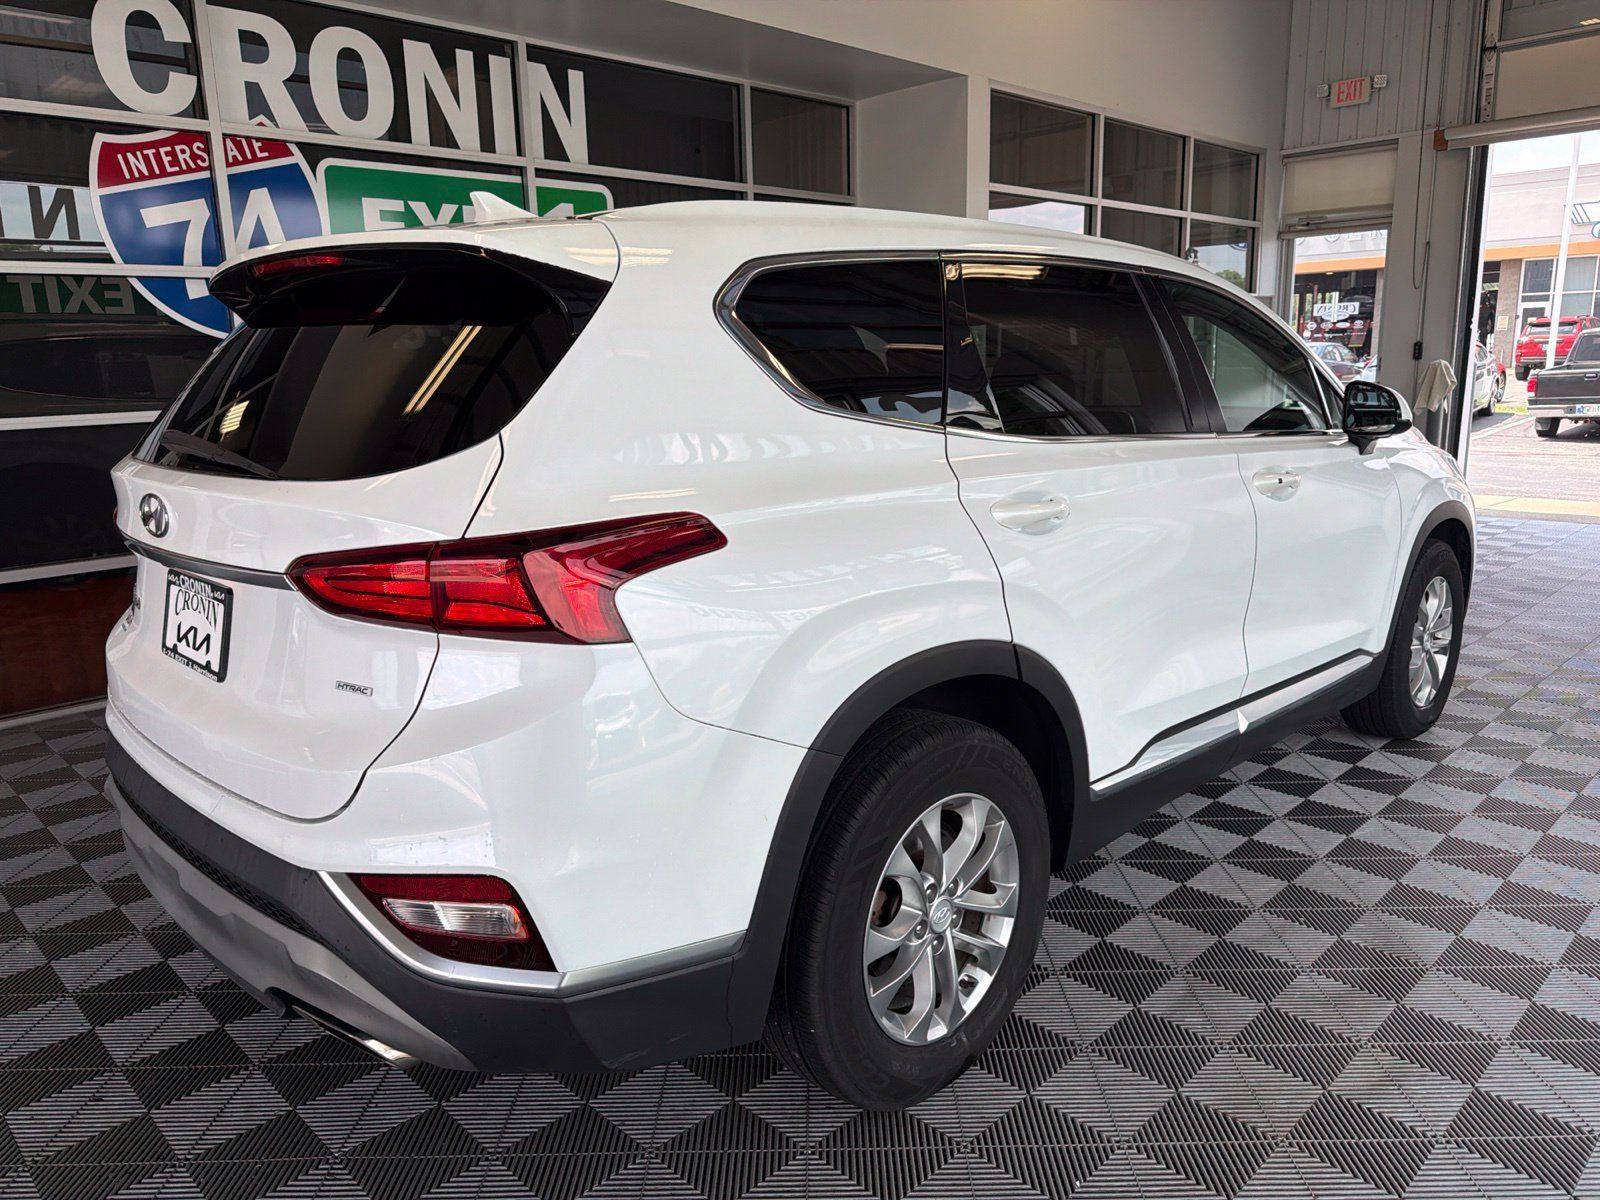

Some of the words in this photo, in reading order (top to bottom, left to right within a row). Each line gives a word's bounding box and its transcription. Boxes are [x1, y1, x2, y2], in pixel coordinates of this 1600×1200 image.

[91, 0, 590, 165] CRONIN
[1336, 78, 1366, 104] EXIT
[116, 136, 269, 180] INTERSATE
[180, 574, 212, 598] CRONIN
[174, 588, 220, 631] CRONIN
[176, 621, 211, 656] KIA
[337, 682, 369, 695] HTRAC
